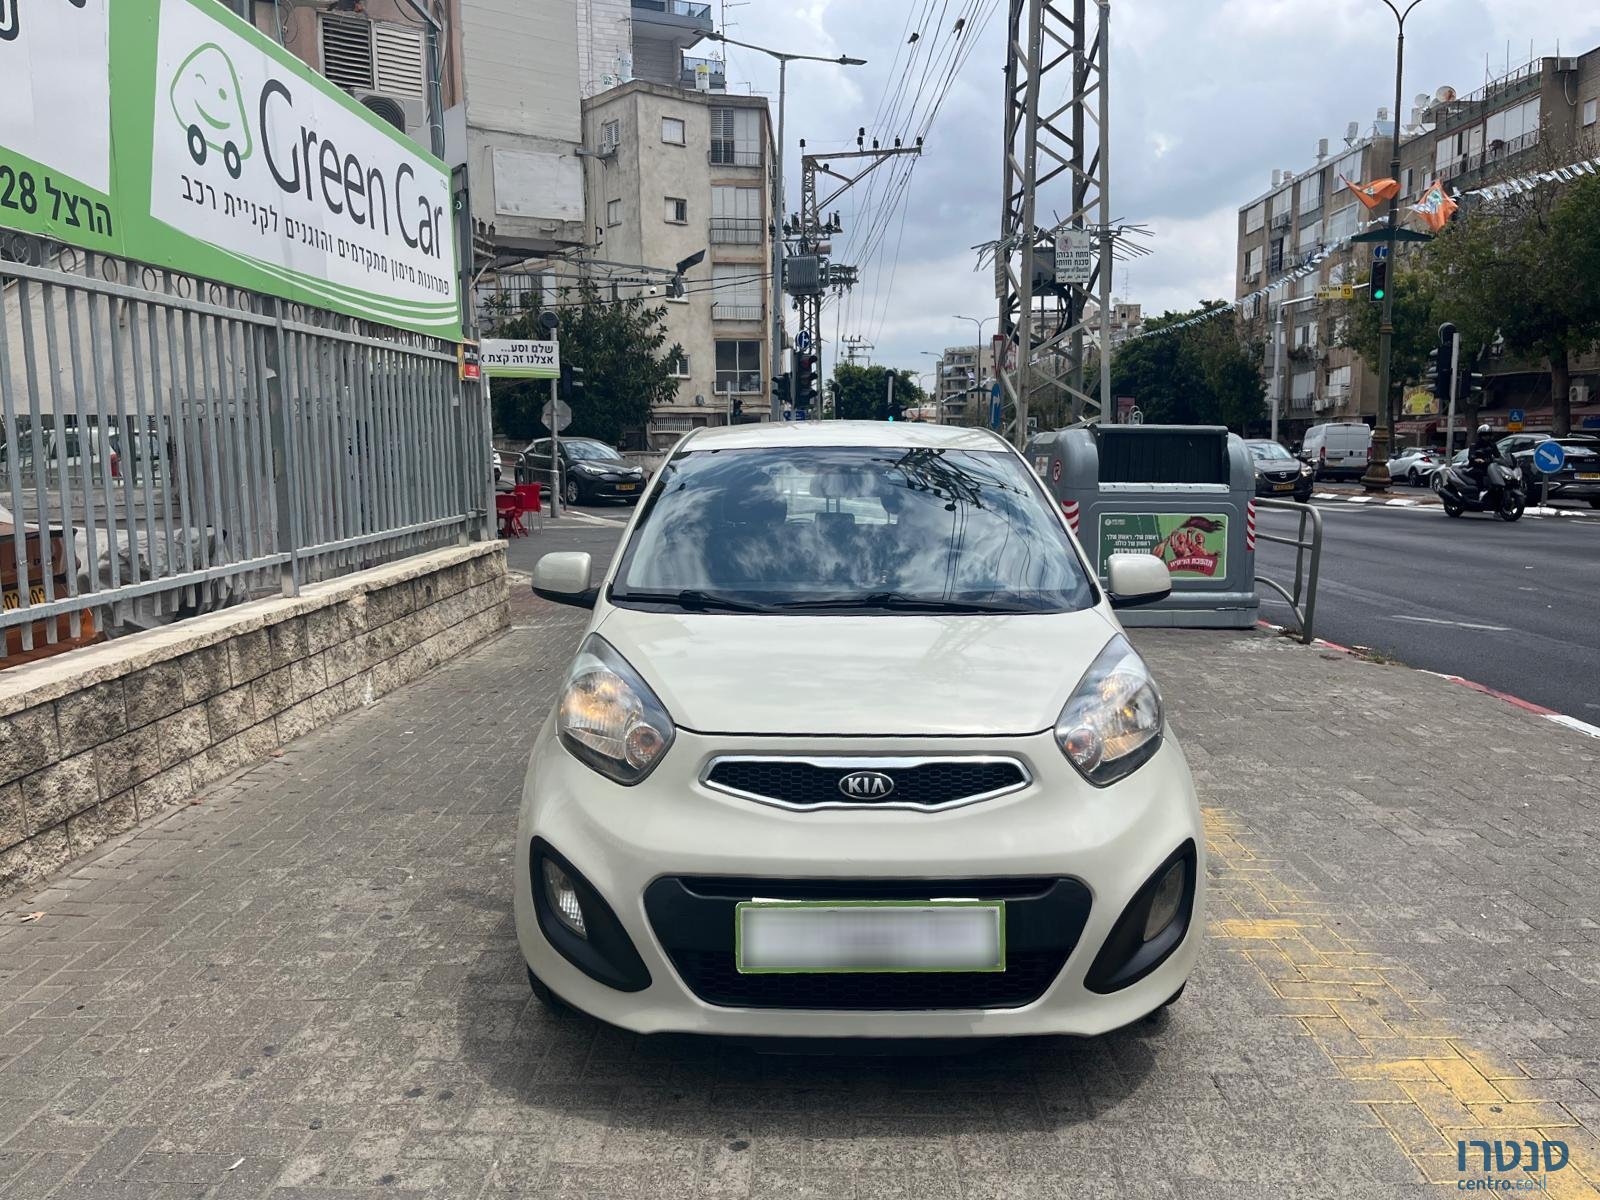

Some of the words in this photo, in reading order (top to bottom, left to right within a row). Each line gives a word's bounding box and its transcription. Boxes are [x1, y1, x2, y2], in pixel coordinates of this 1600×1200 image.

[259, 78, 389, 236] Green
[395, 162, 443, 259] Car
[0, 165, 37, 214] 28
[181, 174, 216, 210] רכב
[44, 176, 113, 237] הרצל
[223, 191, 278, 235] לקניית
[285, 216, 333, 253] והוגנים
[337, 238, 388, 273] מתקדמים
[391, 259, 415, 282] מימון
[418, 270, 449, 295] פתרונות
[488, 354, 510, 365] קצת
[512, 355, 524, 363] זה
[526, 354, 554, 364] אצלנו
[531, 343, 554, 354] שלם
[847, 777, 886, 794] KIA
